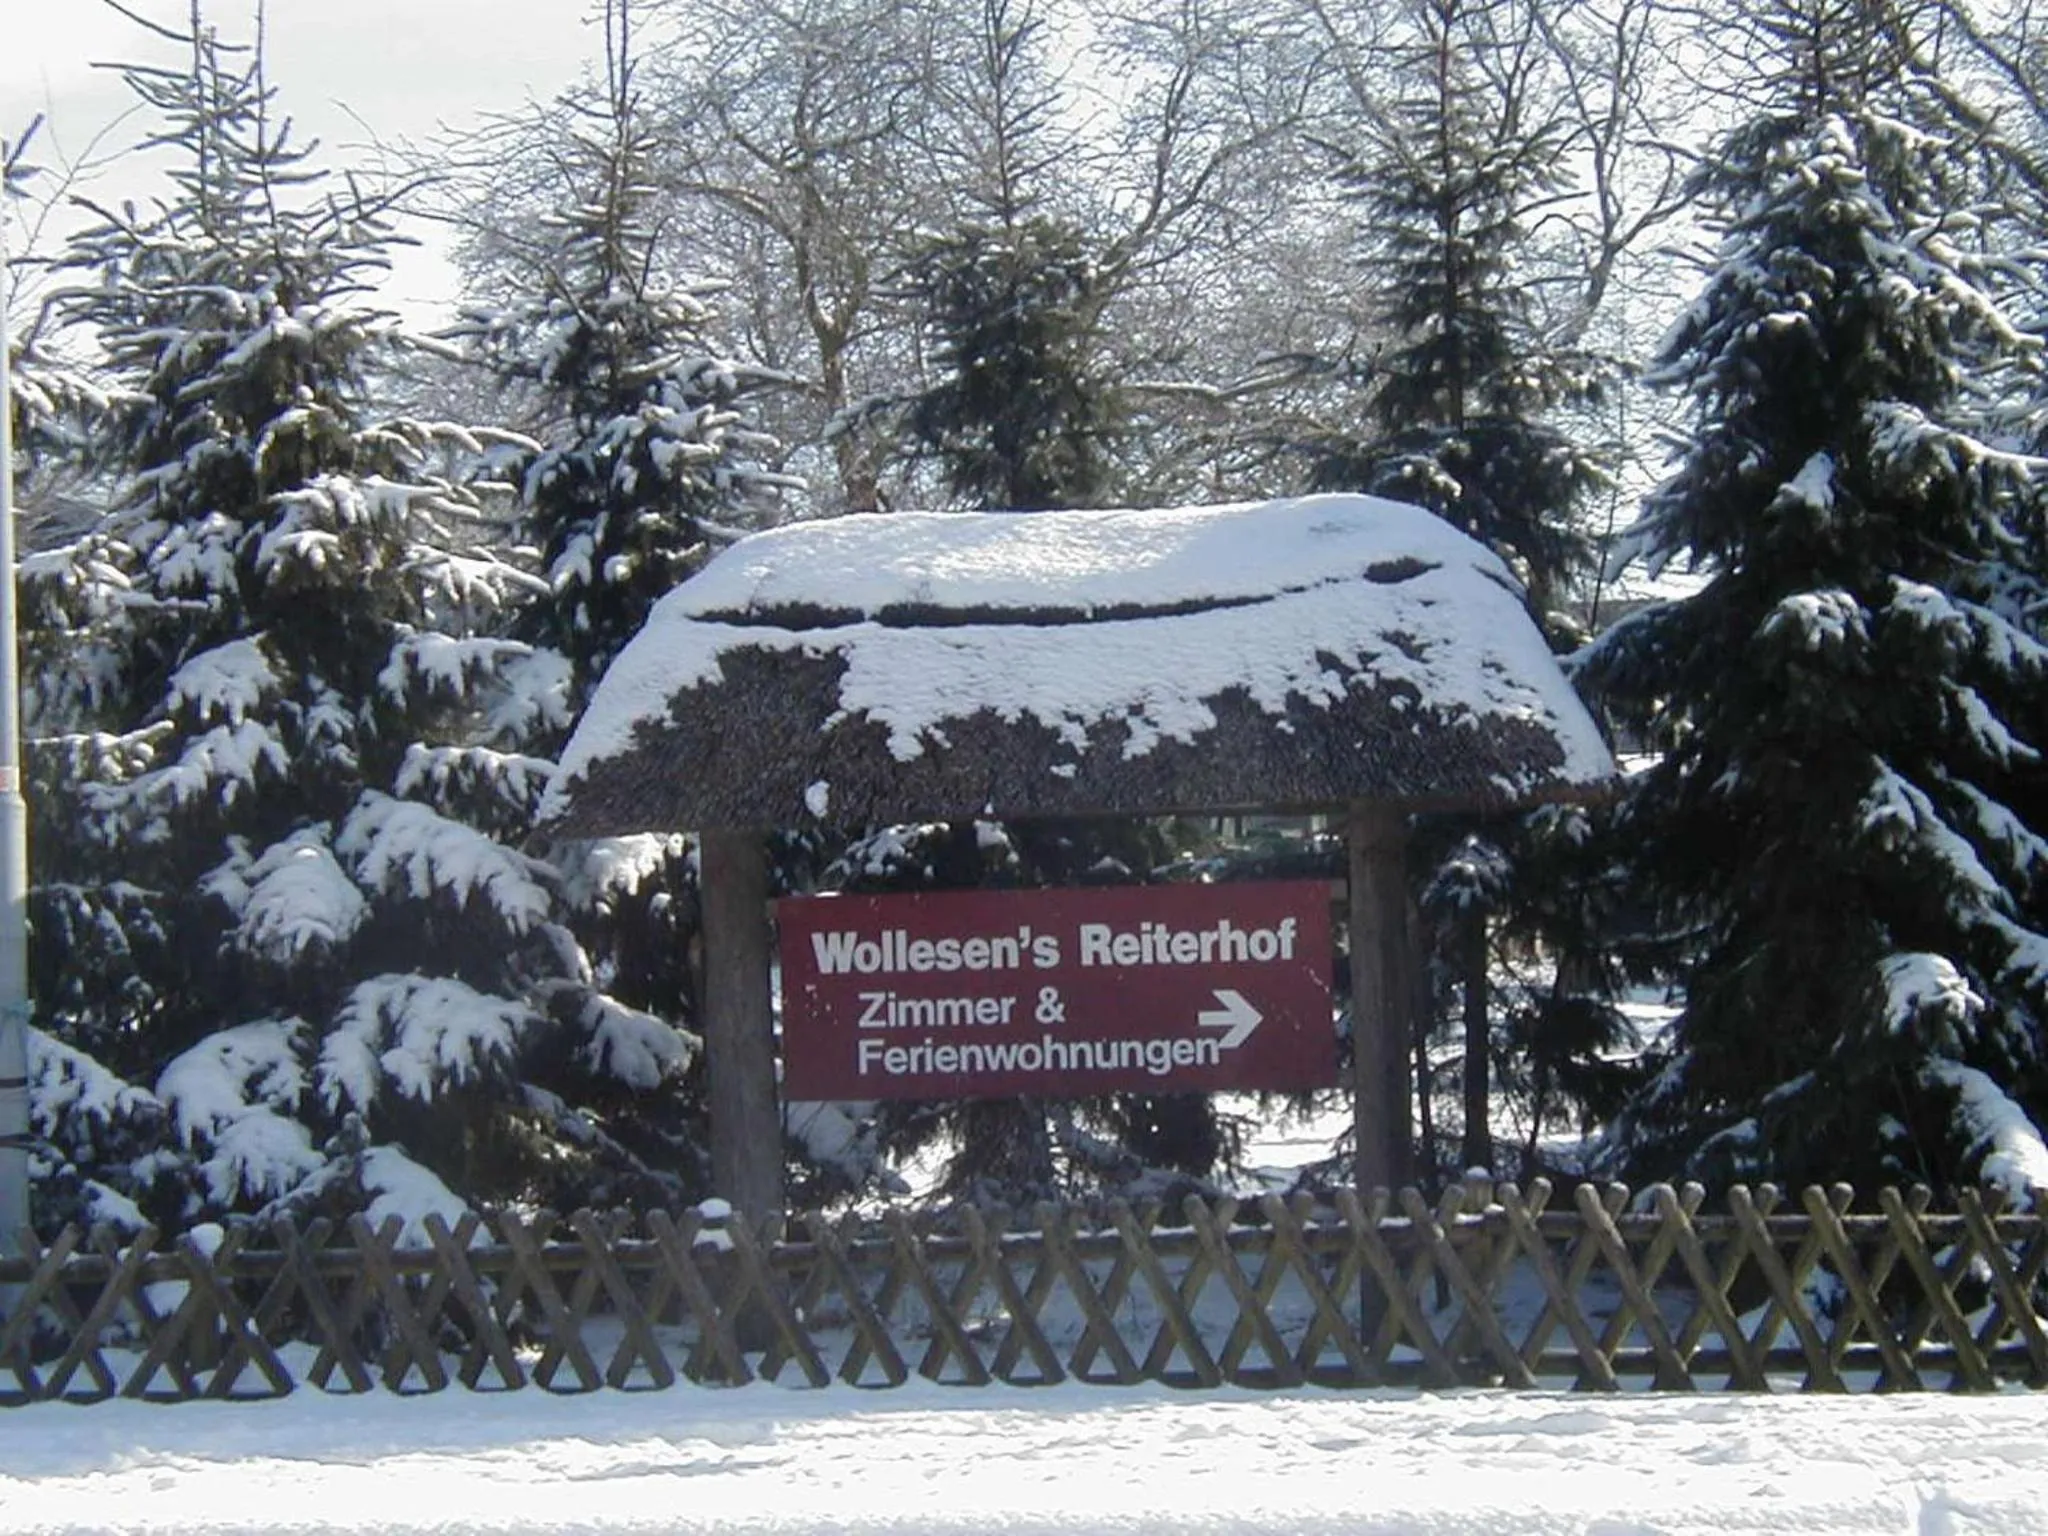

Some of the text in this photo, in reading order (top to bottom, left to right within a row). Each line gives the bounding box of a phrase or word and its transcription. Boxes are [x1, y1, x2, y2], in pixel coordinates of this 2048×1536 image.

[811, 917, 1296, 973] Wollesen's Reiterhof
[858, 987, 1066, 1028] Zimmer &
[858, 1035, 1221, 1075] Ferienwohnungen
